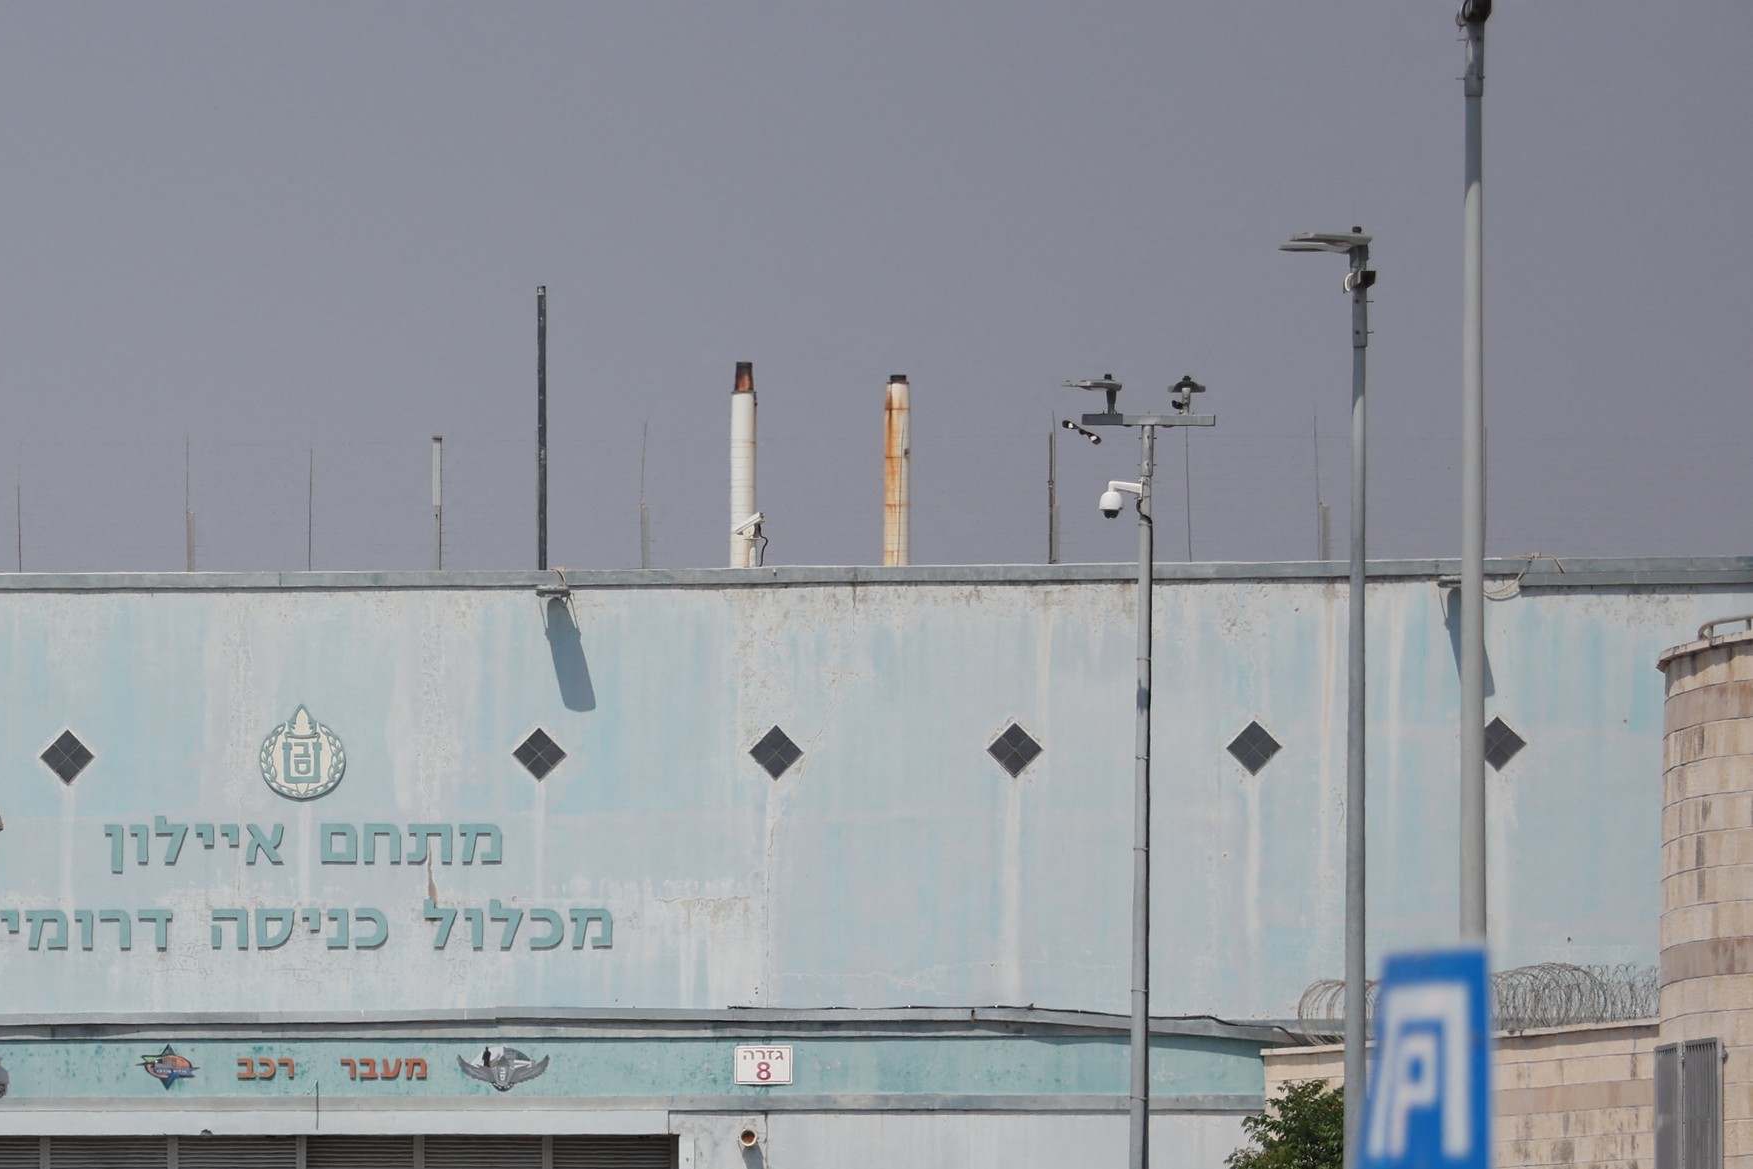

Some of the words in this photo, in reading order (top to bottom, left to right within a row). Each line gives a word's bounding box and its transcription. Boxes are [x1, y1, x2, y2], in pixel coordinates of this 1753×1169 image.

[104, 815, 285, 873] איילון
[319, 822, 503, 866] מתחם
[0, 907, 173, 952] דרומי
[210, 907, 390, 951] כניסה
[424, 899, 614, 952] מכלול
[236, 1056, 296, 1081] רכב
[339, 1056, 428, 1081] מעבר
[742, 1050, 784, 1061] גזרה
[755, 1061, 772, 1081] 8
